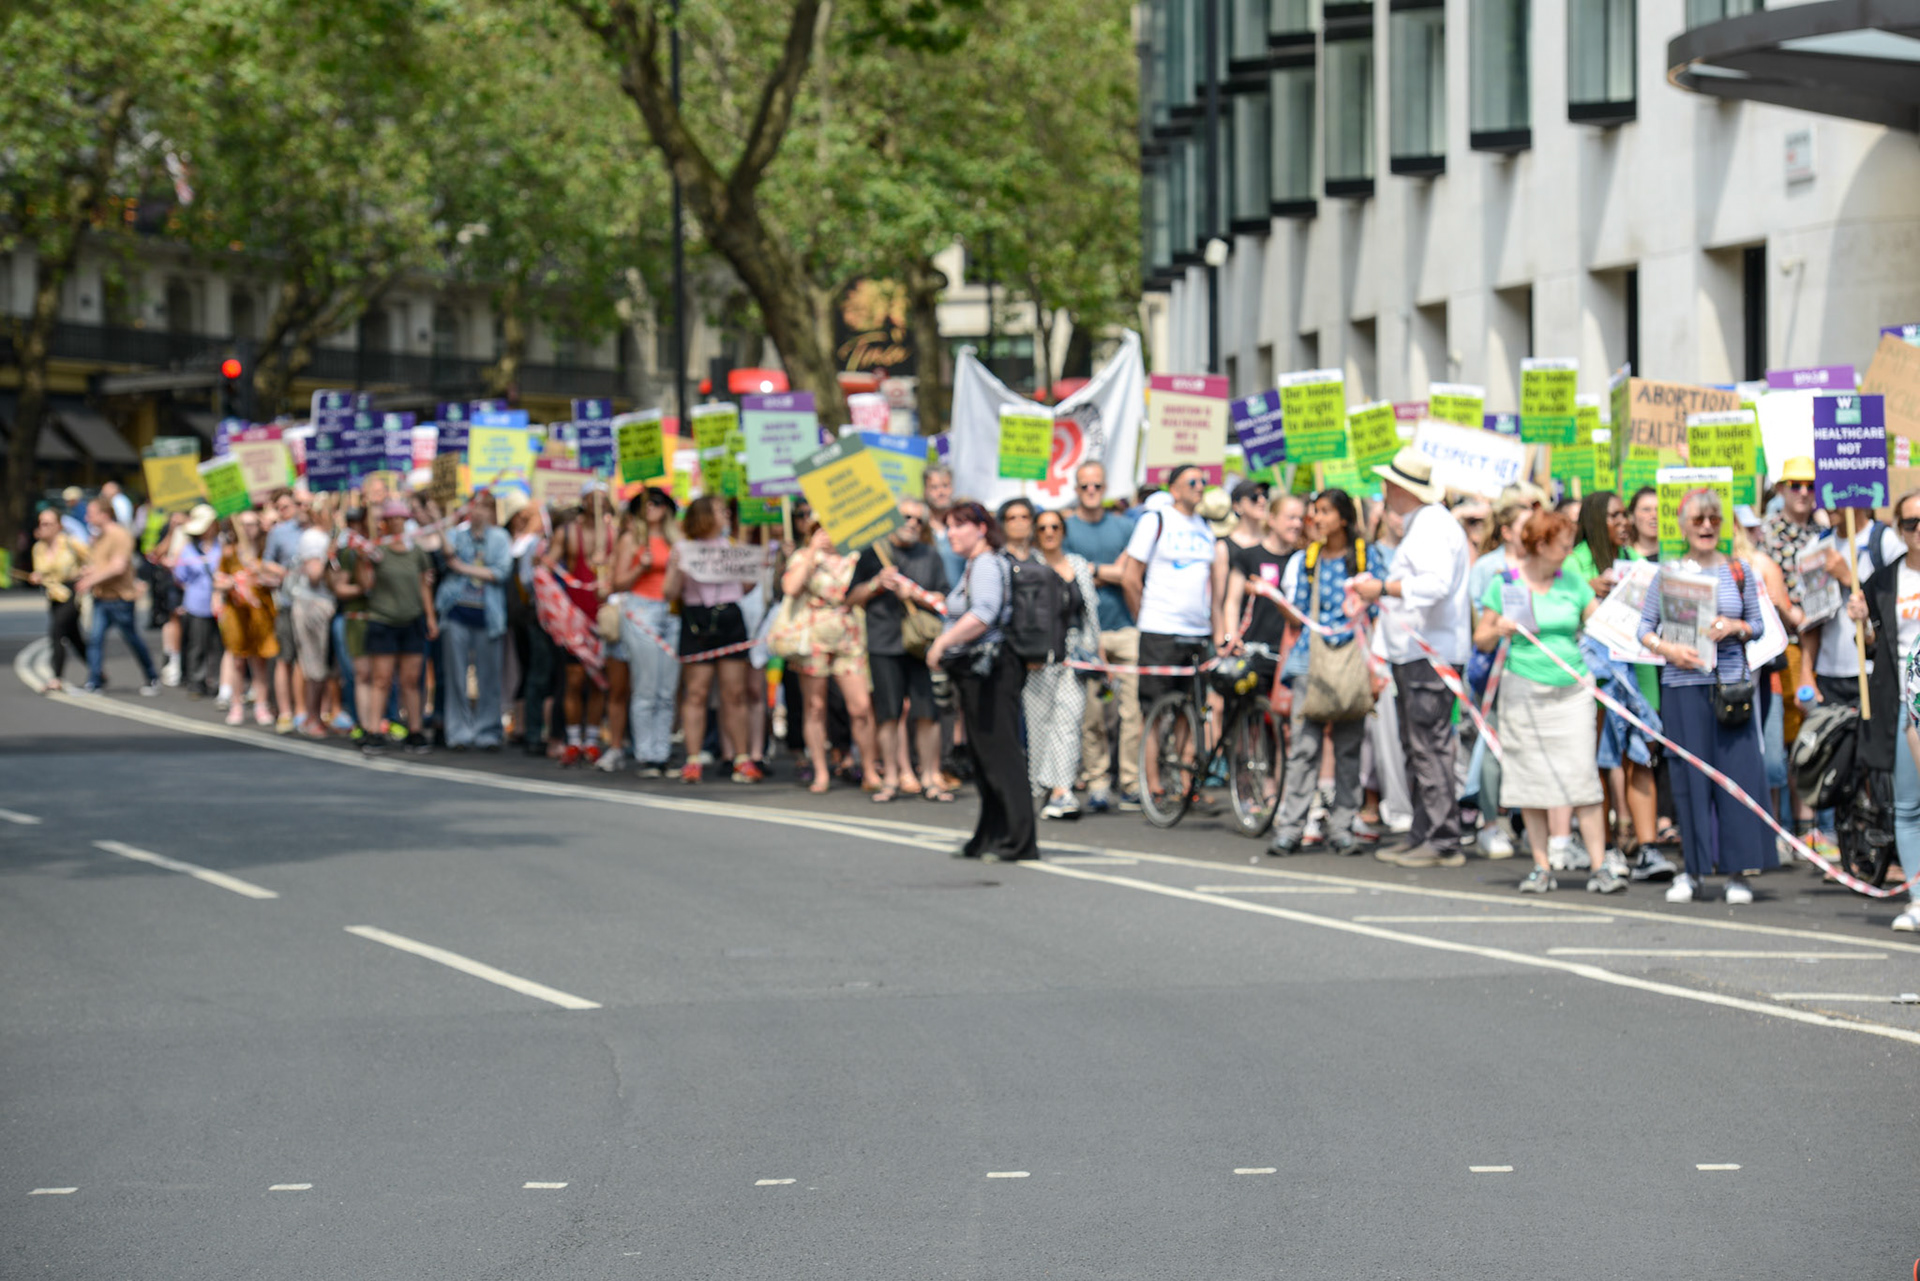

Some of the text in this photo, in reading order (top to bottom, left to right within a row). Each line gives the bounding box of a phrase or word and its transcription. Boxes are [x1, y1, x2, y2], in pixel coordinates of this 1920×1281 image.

[1637, 385, 1733, 411] ABORTION
[1691, 425, 1752, 440] Our bodies
[1814, 427, 1886, 440] HEALTHCARE
[1692, 443, 1744, 459] Our right
[1836, 442, 1862, 455] NOT
[1818, 457, 1886, 470] HANDCUFFS
[1661, 485, 1683, 498] Our
[1662, 504, 1679, 517] Ou
[1663, 523, 1676, 536] to
